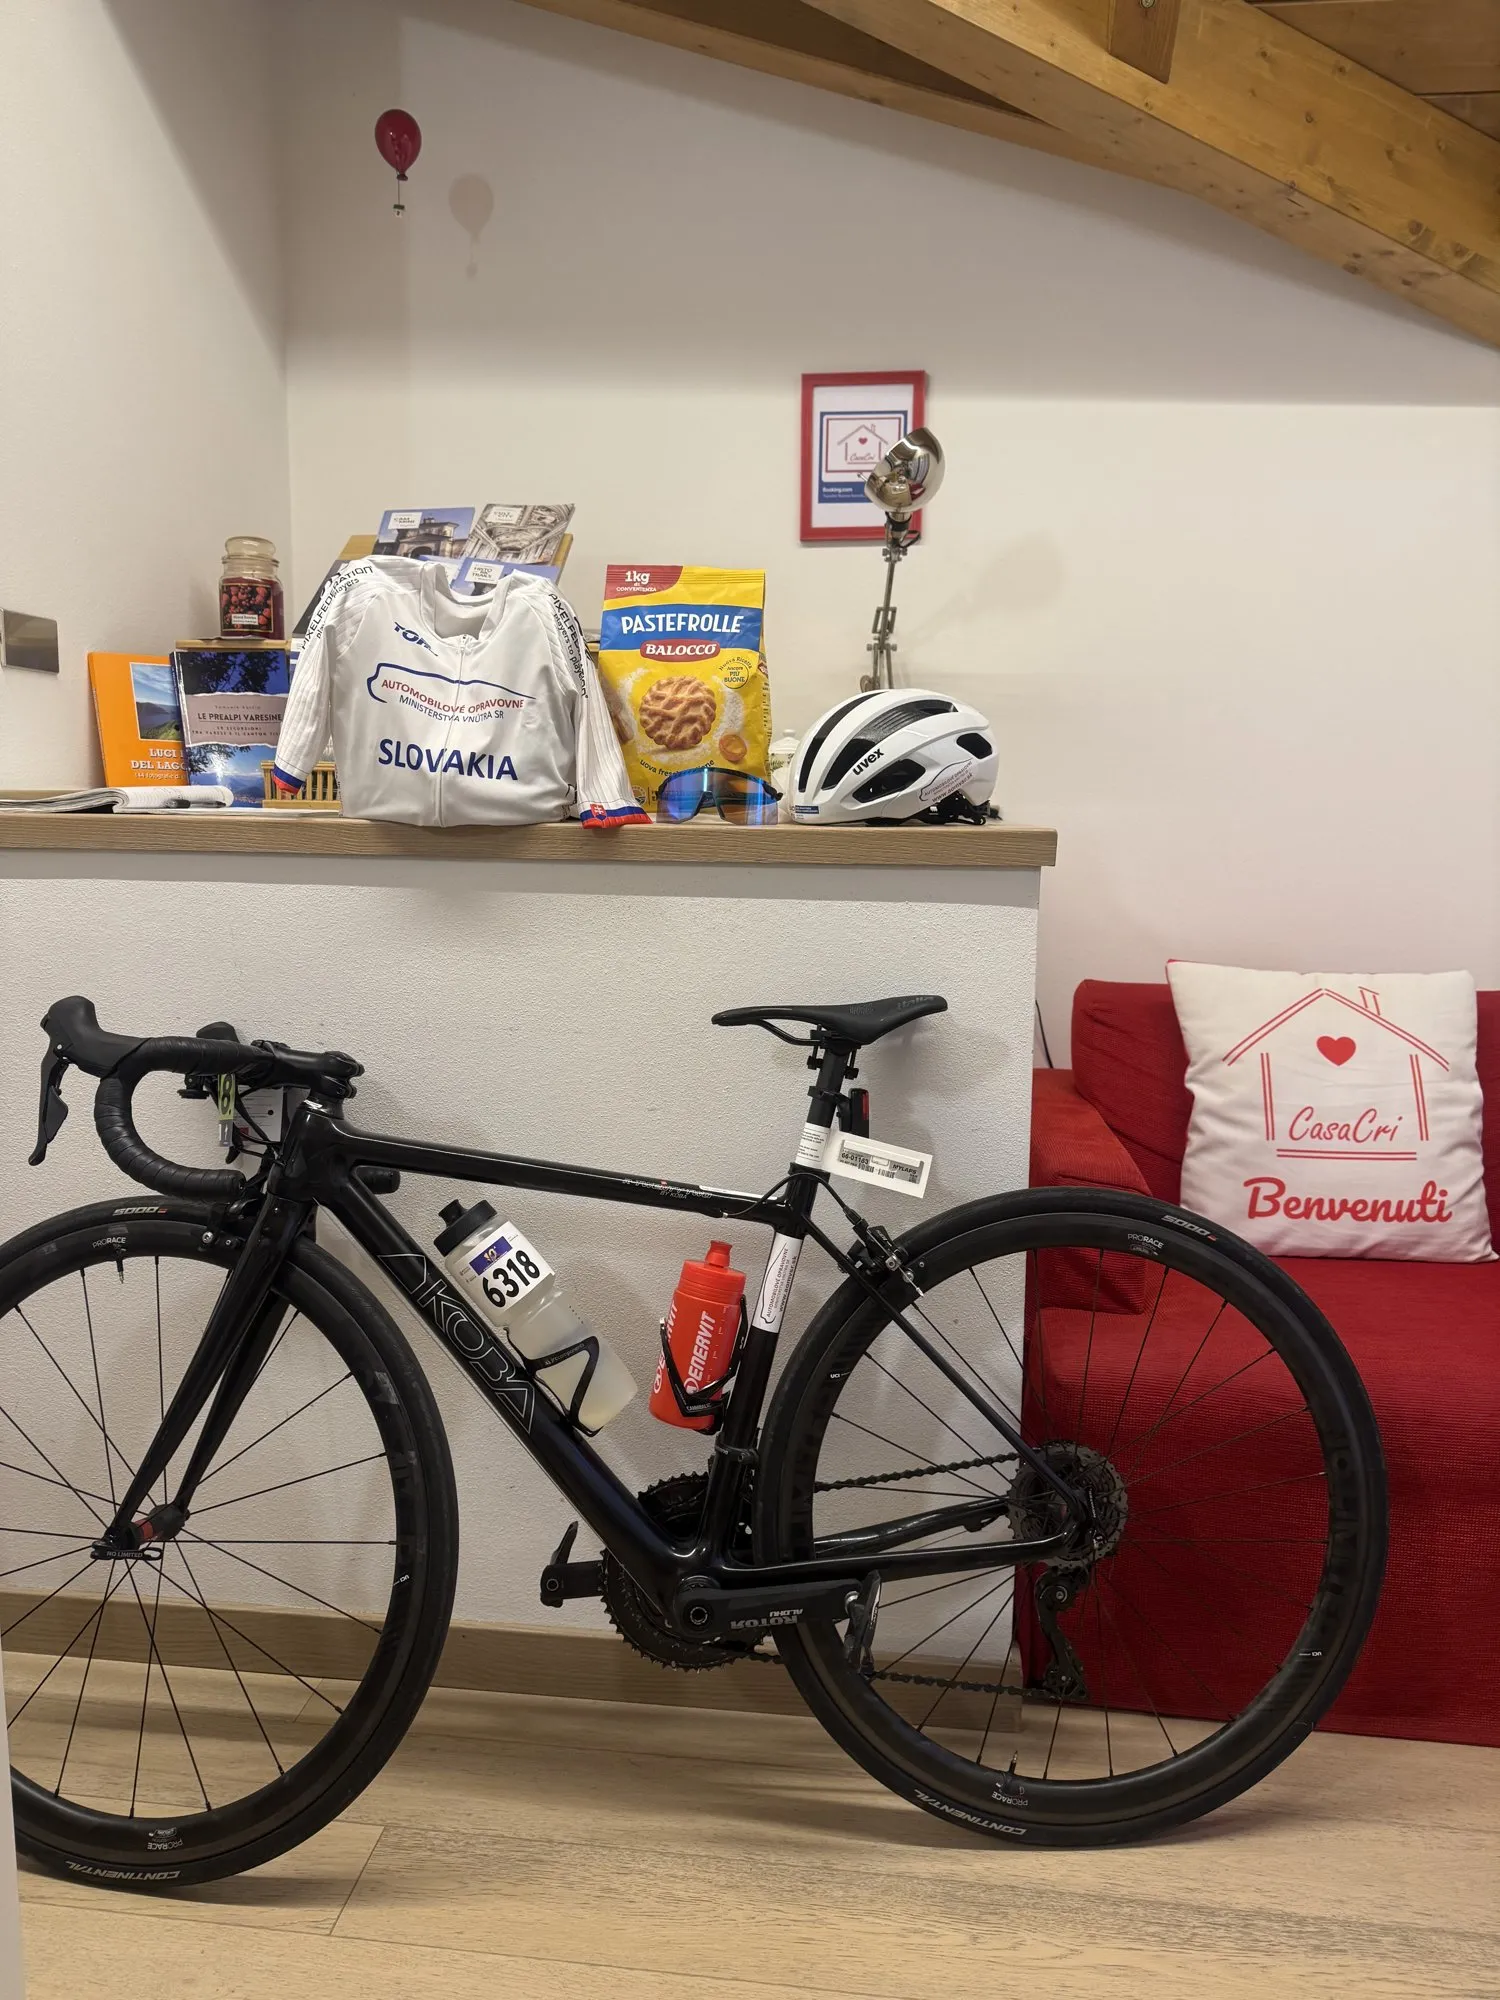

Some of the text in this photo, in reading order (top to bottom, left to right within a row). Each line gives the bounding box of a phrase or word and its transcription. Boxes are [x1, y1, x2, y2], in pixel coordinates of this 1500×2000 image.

[625, 570, 650, 585] 1kg
[621, 613, 744, 635] PASTEFROLLE
[567, 644, 574, 655] to
[645, 643, 717, 656] BALOCCO
[382, 679, 524, 714] AUTOMOBILOVÉ OPRAVOVNE
[197, 712, 283, 721] LE PREALPI VARESINE
[399, 695, 504, 723] MINISTERSTVA VNÚTRA SR
[149, 748, 177, 759] LUCI
[378, 738, 518, 781] SLOVAKIA
[131, 760, 155, 770] DEL
[640, 759, 657, 774] uova
[852, 747, 885, 776] uvex
[1288, 1106, 1403, 1144] CasaCri
[893, 1164, 917, 1175] MYLAPS
[1243, 1177, 1453, 1223] Benvenuti
[112, 1206, 160, 1217] 5000
[1161, 1214, 1211, 1236] 5000
[92, 1236, 127, 1249] PRORACE
[1127, 1233, 1164, 1249] PRORACE
[482, 1249, 540, 1308] 6318
[688, 1310, 716, 1381] ENERVIT
[416, 1279, 536, 1435] KOBA
[769, 1608, 804, 1618] ALDHU
[730, 1615, 798, 1630] ROTOR
[992, 1791, 1029, 1806] PRORACE
[914, 1788, 1028, 1835] CONTINENTAL
[147, 1838, 183, 1850] PRORACE
[65, 1860, 181, 1880] CONTINENTAL
